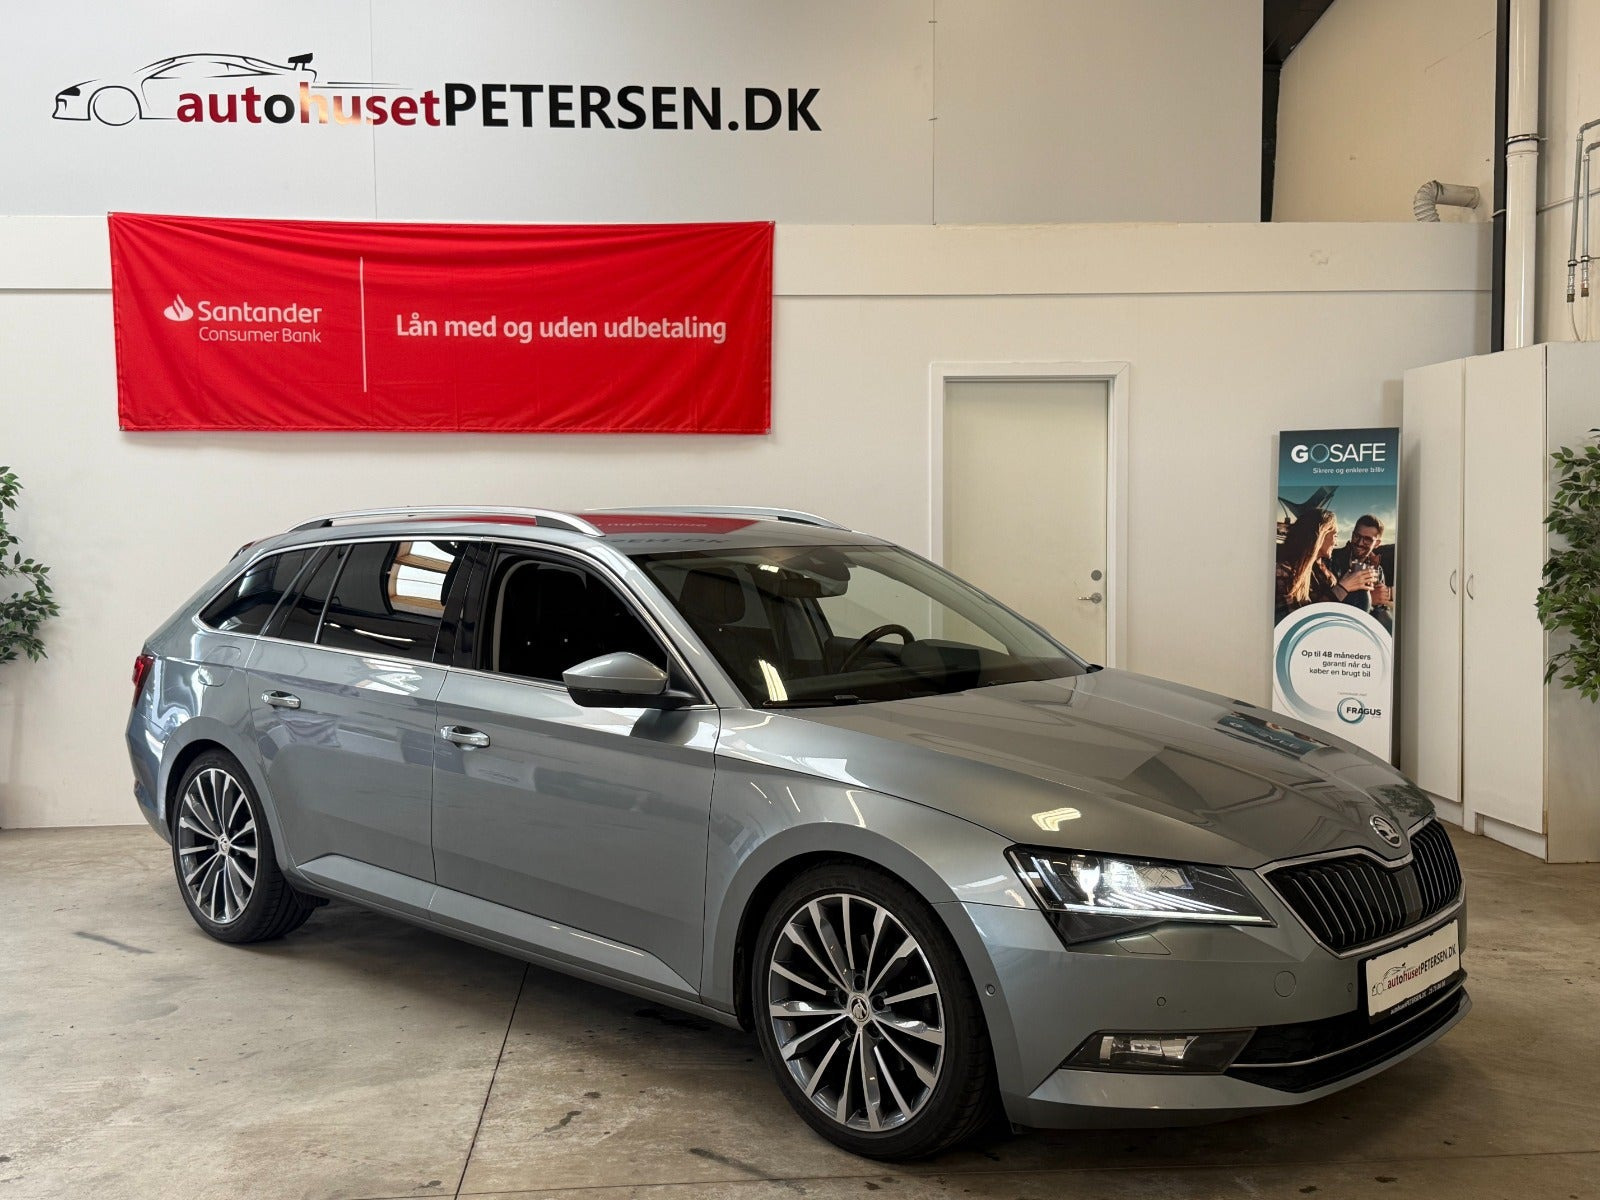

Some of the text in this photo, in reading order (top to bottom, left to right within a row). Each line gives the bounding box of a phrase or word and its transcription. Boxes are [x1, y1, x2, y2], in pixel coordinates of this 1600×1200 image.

[177, 82, 822, 132] autohusetPETERSEN.DK
[198, 300, 323, 324] Santander
[199, 326, 321, 343] Consumer Bank
[396, 312, 727, 344] Lån med og uden udbetaling
[1291, 443, 1386, 464] GOSAFE
[1301, 650, 1313, 658] Op
[1333, 652, 1371, 660] måneders
[1341, 669, 1361, 678] brugt
[1346, 706, 1382, 716] FRAGUS
[1387, 943, 1456, 989] autohusetPETERSEN.DK
